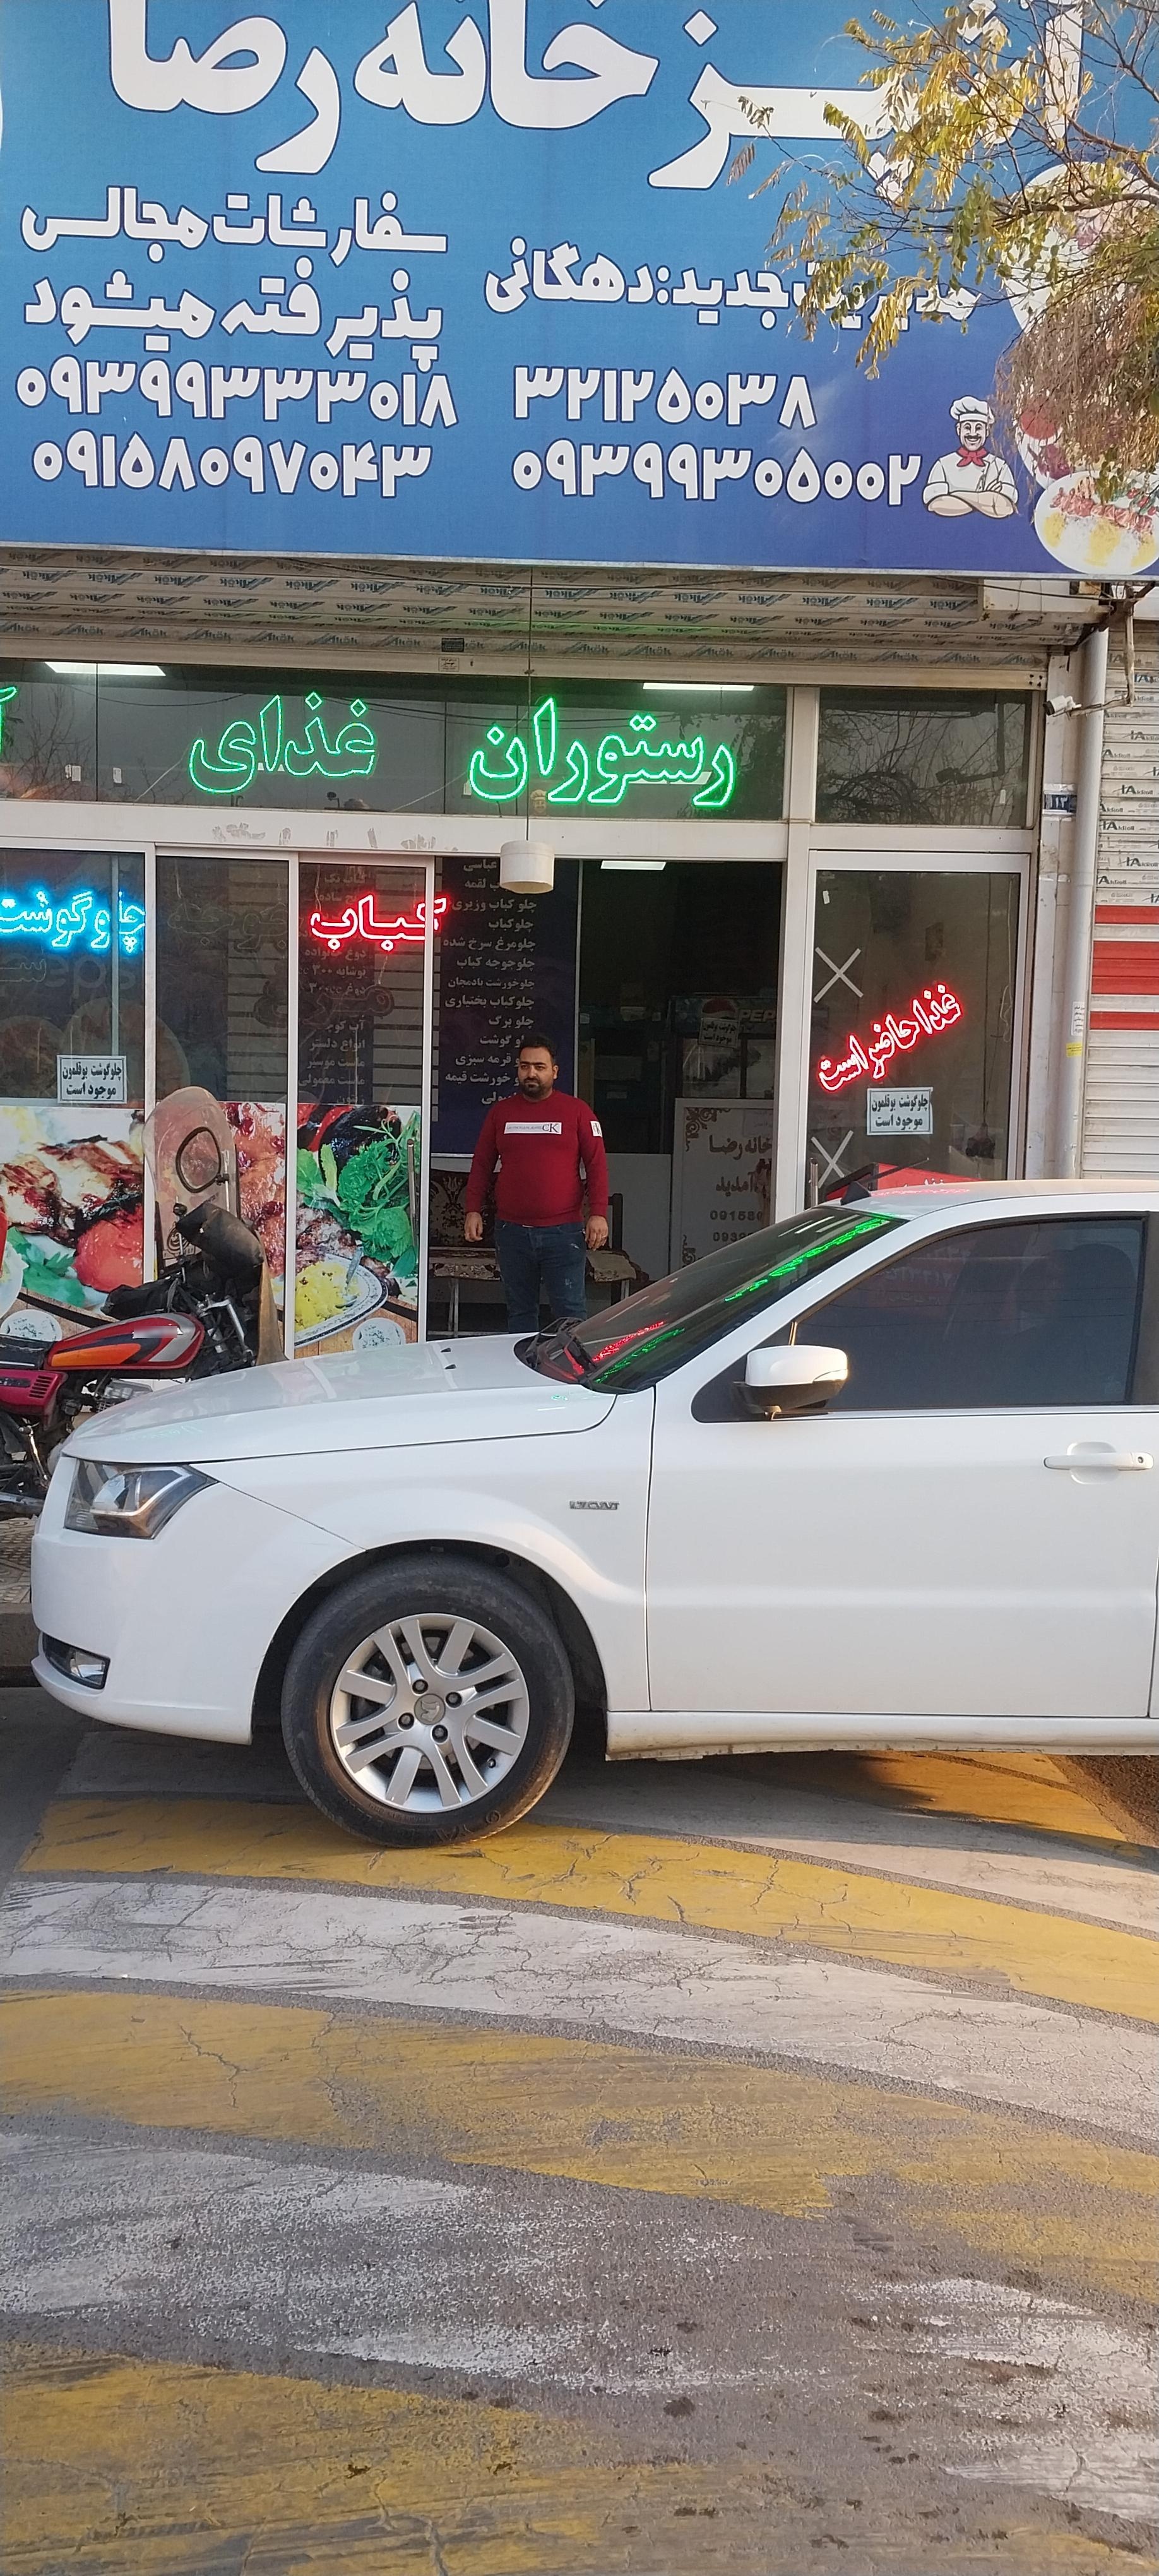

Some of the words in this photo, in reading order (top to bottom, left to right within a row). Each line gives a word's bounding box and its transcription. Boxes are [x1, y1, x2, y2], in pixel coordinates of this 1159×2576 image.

[23, 270, 215, 352] میشود
[513, 366, 819, 431] ۳۲۱۲۵۰۳۸
[32, 429, 431, 498] ۰۹۱۵۸۰۹۷۰۴۳
[511, 439, 922, 506] ۰۹۳۹۹۳۰۵۰۰۲
[189, 692, 376, 794] غذای
[469, 696, 735, 806] رستوران
[489, 898, 515, 912] کباب
[456, 956, 483, 970] کباب
[515, 1016, 534, 1030] چلو
[819, 1035, 869, 1091] است
[66, 1082, 86, 1095] است
[88, 1084, 117, 1100] موجود
[875, 1113, 894, 1127] است
[896, 1116, 923, 1131] موجود
